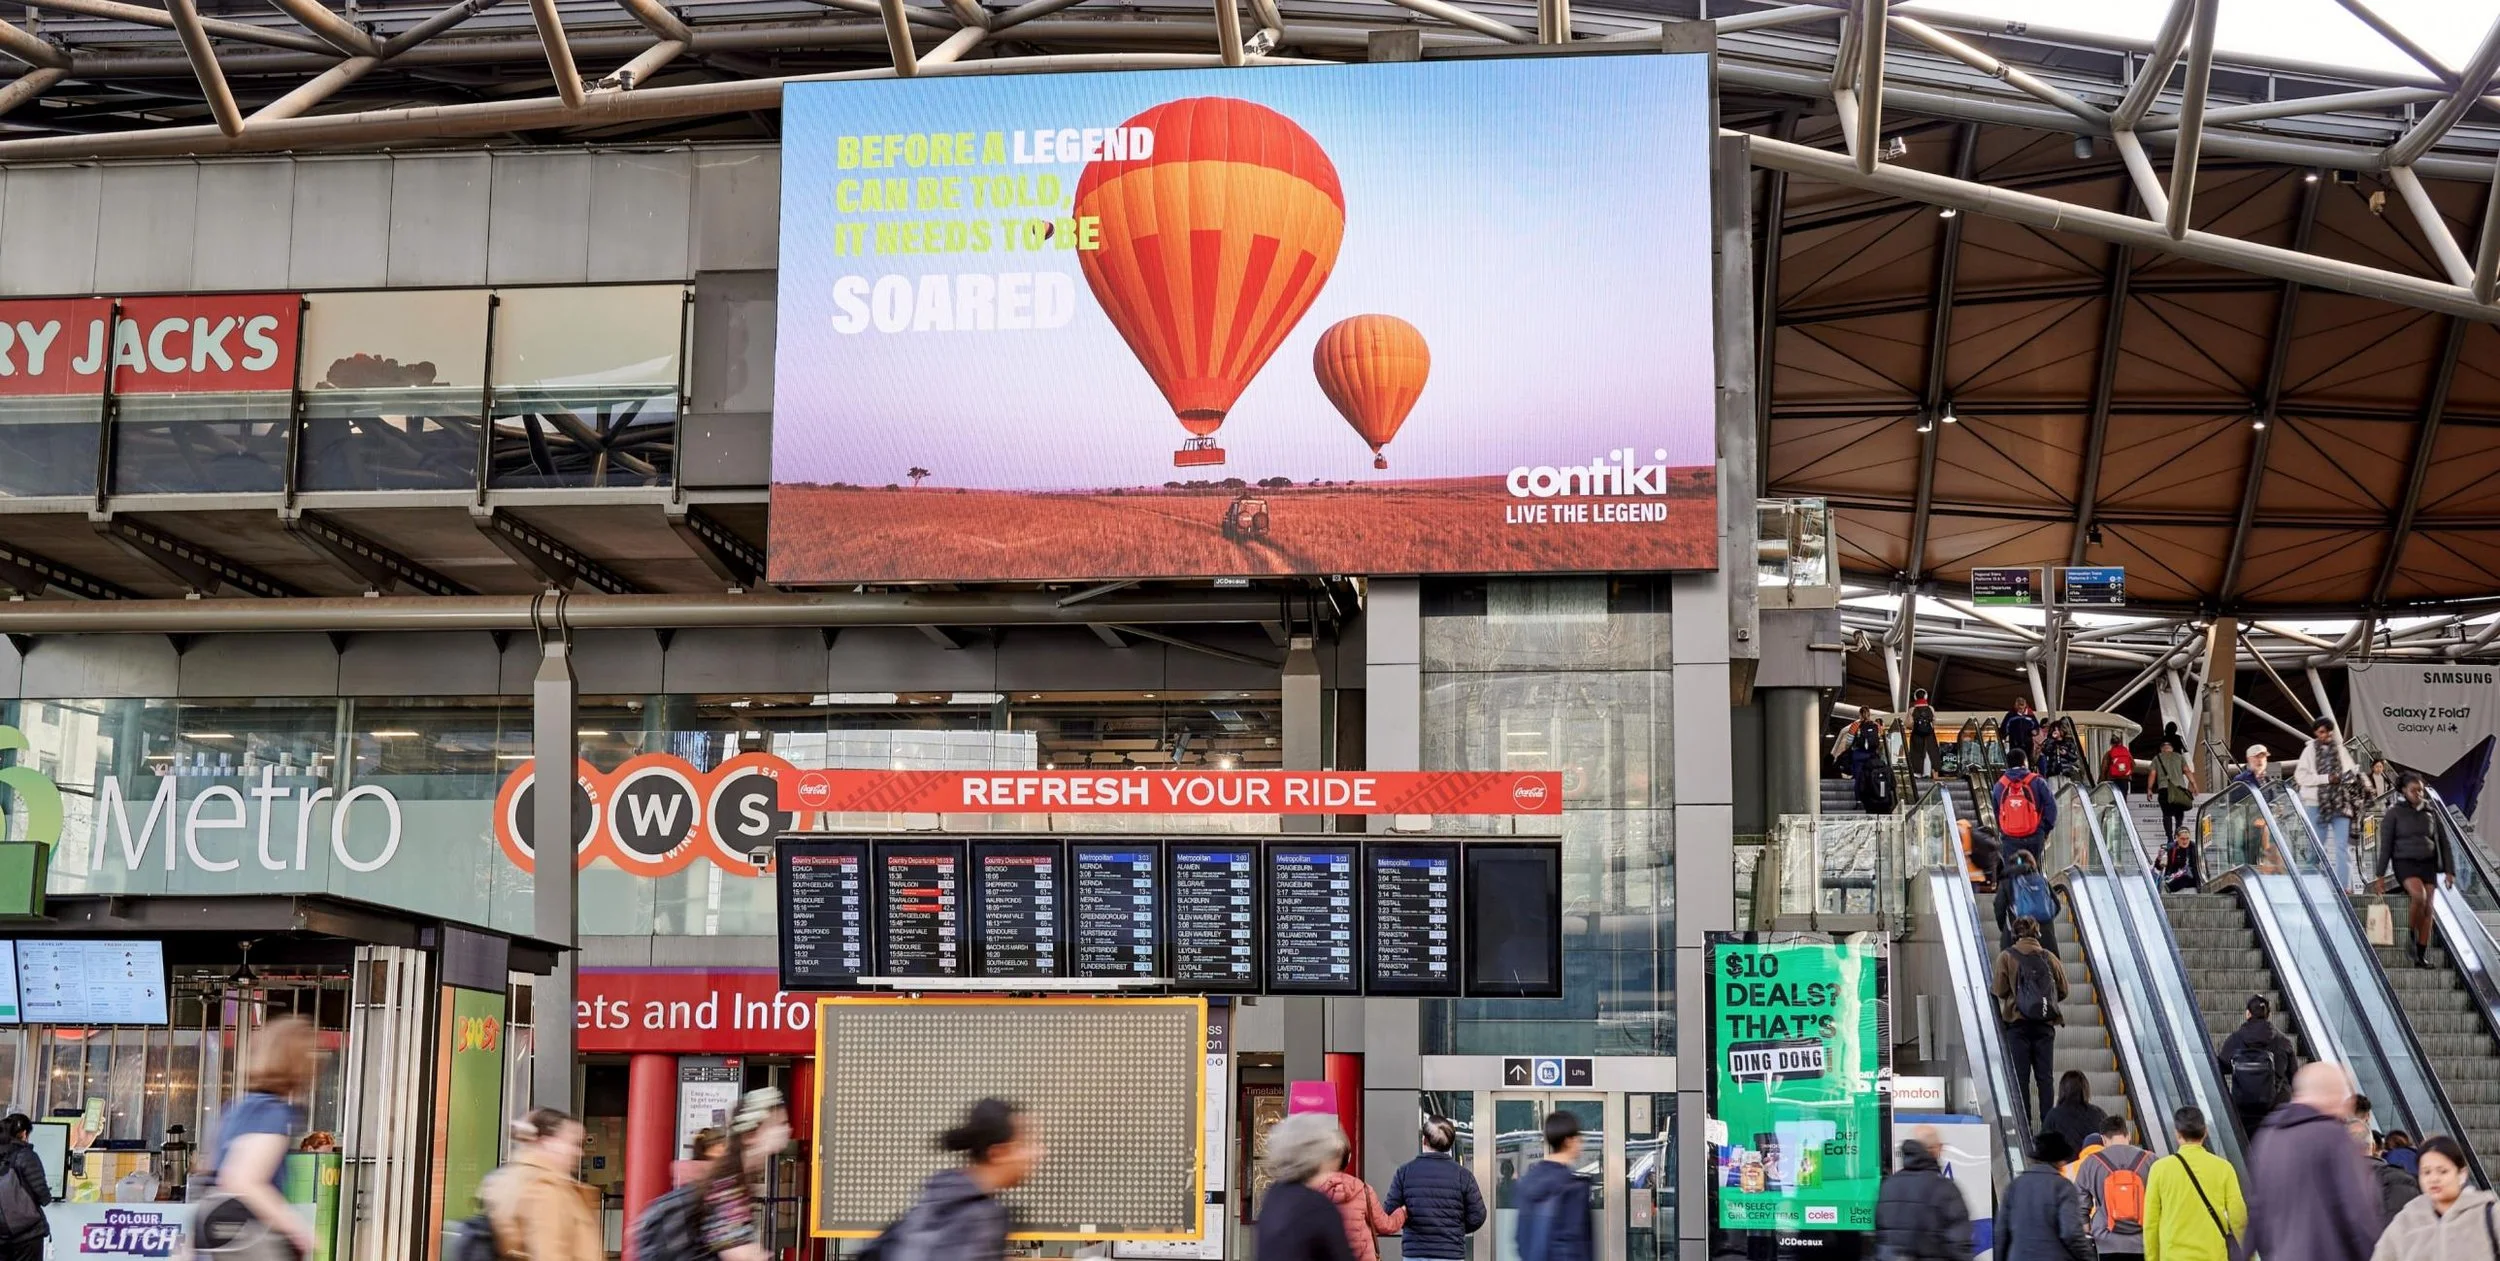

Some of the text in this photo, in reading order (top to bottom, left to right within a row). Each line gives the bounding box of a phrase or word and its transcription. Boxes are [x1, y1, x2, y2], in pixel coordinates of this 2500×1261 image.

[837, 126, 1155, 170] BEFORE A LEGEND
[836, 173, 1072, 214] CAN BE TOLD,
[834, 215, 1100, 257] IT NEEDS TO BE
[832, 271, 1076, 335] SOARED
[72, 313, 280, 376] JACK'S
[1506, 447, 1668, 498] contiki
[1506, 502, 1668, 525] LIVE THE LEGEND
[2424, 672, 2492, 684] SAMSUNG
[2383, 707, 2470, 720] Galaxy Z Fold7
[2398, 723, 2446, 735] Galaxy AI
[578, 775, 598, 801] EER
[963, 777, 1376, 807] REFRESH YOUR RIDE
[1514, 786, 1546, 798] Coca-Cola
[92, 764, 402, 872] Metro
[627, 793, 770, 837] W S
[666, 828, 697, 860] WINE
[985, 857, 1004, 865] Country
[1177, 854, 1211, 862] Metropolitan
[1276, 855, 1311, 863] Metropolitan
[1377, 859, 1410, 867] Metropolitan
[1726, 952, 1779, 979] $10
[1726, 983, 1841, 1007] DEALS?
[577, 990, 817, 1031] ets and Info
[458, 1015, 500, 1054] BOOST
[1726, 1014, 1837, 1039] THAT'S
[1734, 1050, 1822, 1072] DING DONG
[1892, 1087, 1940, 1099] omaton
[1824, 1143, 1858, 1156] Eats
[1745, 1202, 1776, 1211] SELECT
[1808, 1210, 1835, 1220] coles
[1850, 1207, 1872, 1215] Uber
[109, 1213, 159, 1225] COLOUR
[1850, 1216, 1872, 1224] Eats
[87, 1225, 178, 1251] GLITCH
[1780, 1237, 1823, 1246] JCDecaux
